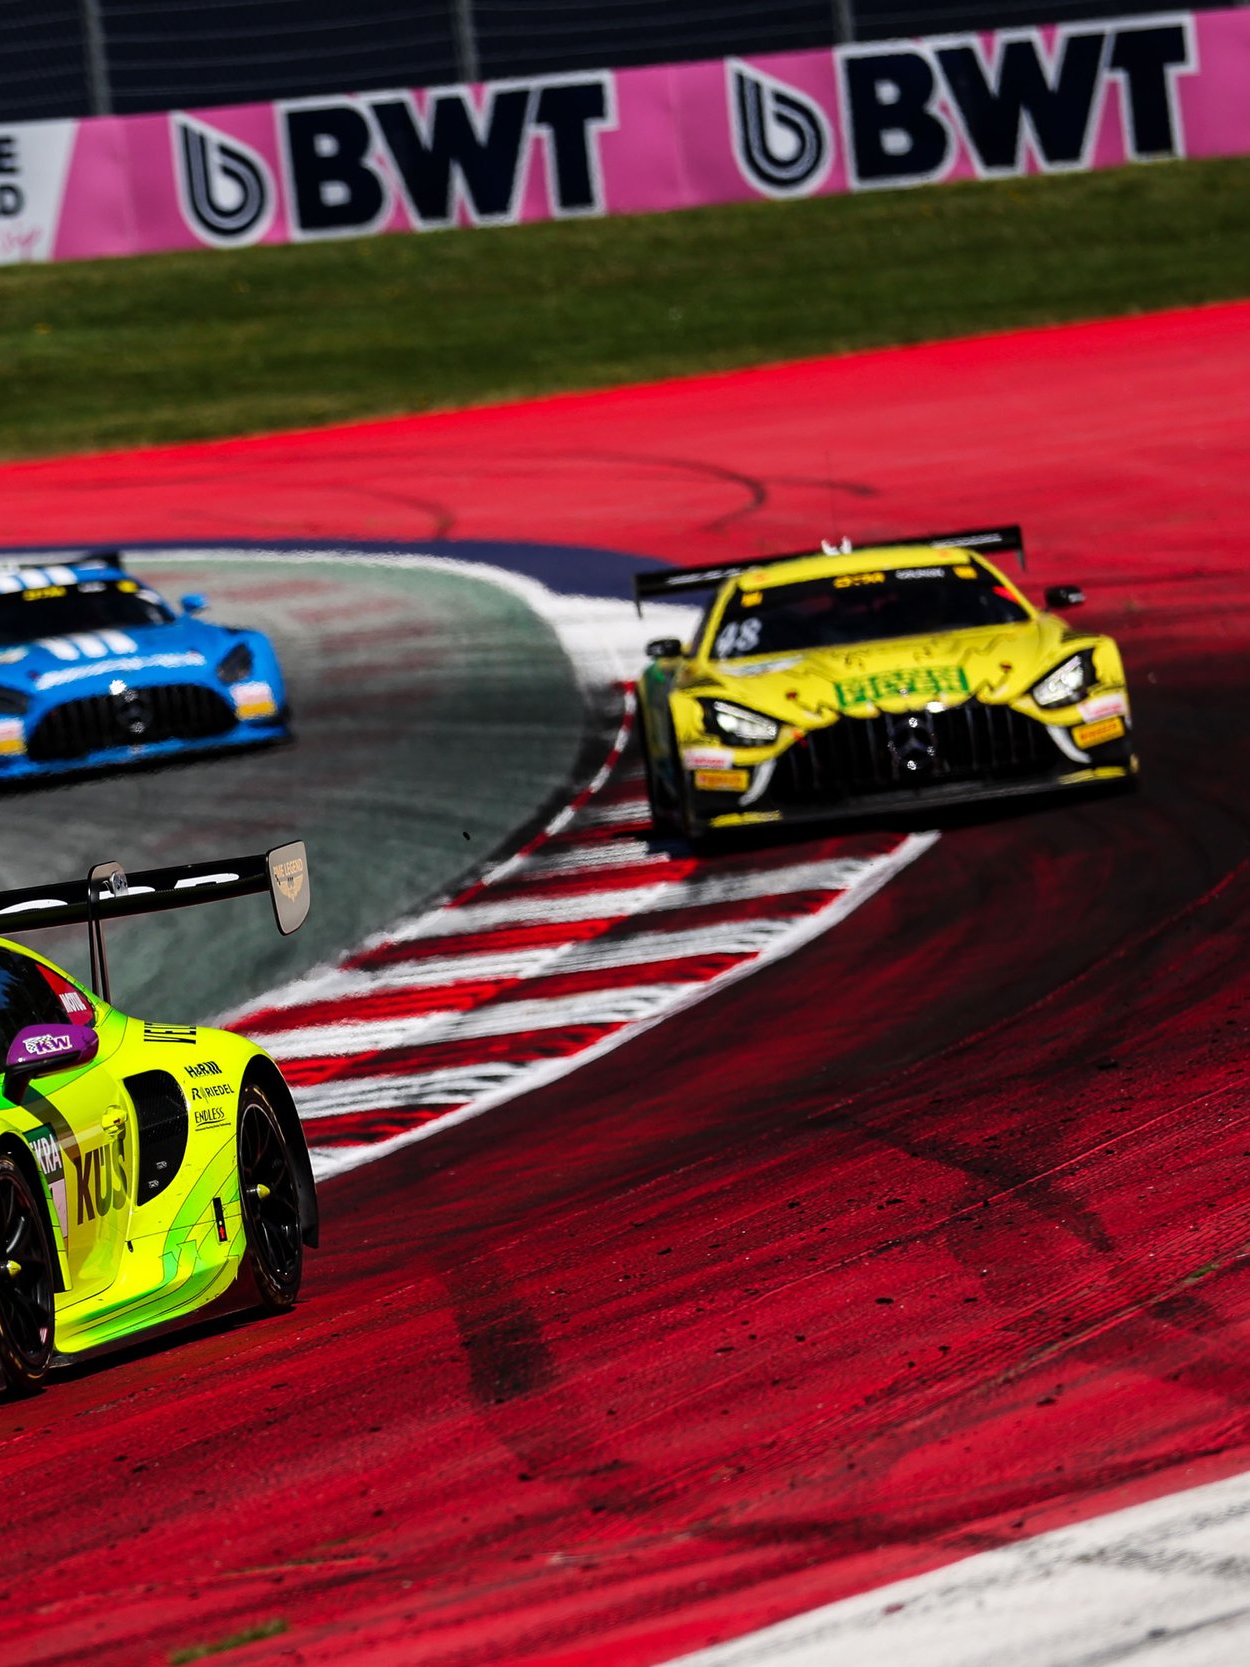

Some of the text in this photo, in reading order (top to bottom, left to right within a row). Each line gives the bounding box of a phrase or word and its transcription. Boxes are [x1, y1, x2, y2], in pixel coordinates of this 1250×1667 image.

[840, 18, 1193, 187] BWT
[280, 76, 612, 237] BWT
[35, 1035, 72, 1055] KW
[205, 1084, 234, 1098] RIEDEL
[195, 1107, 225, 1123] ENDLESS
